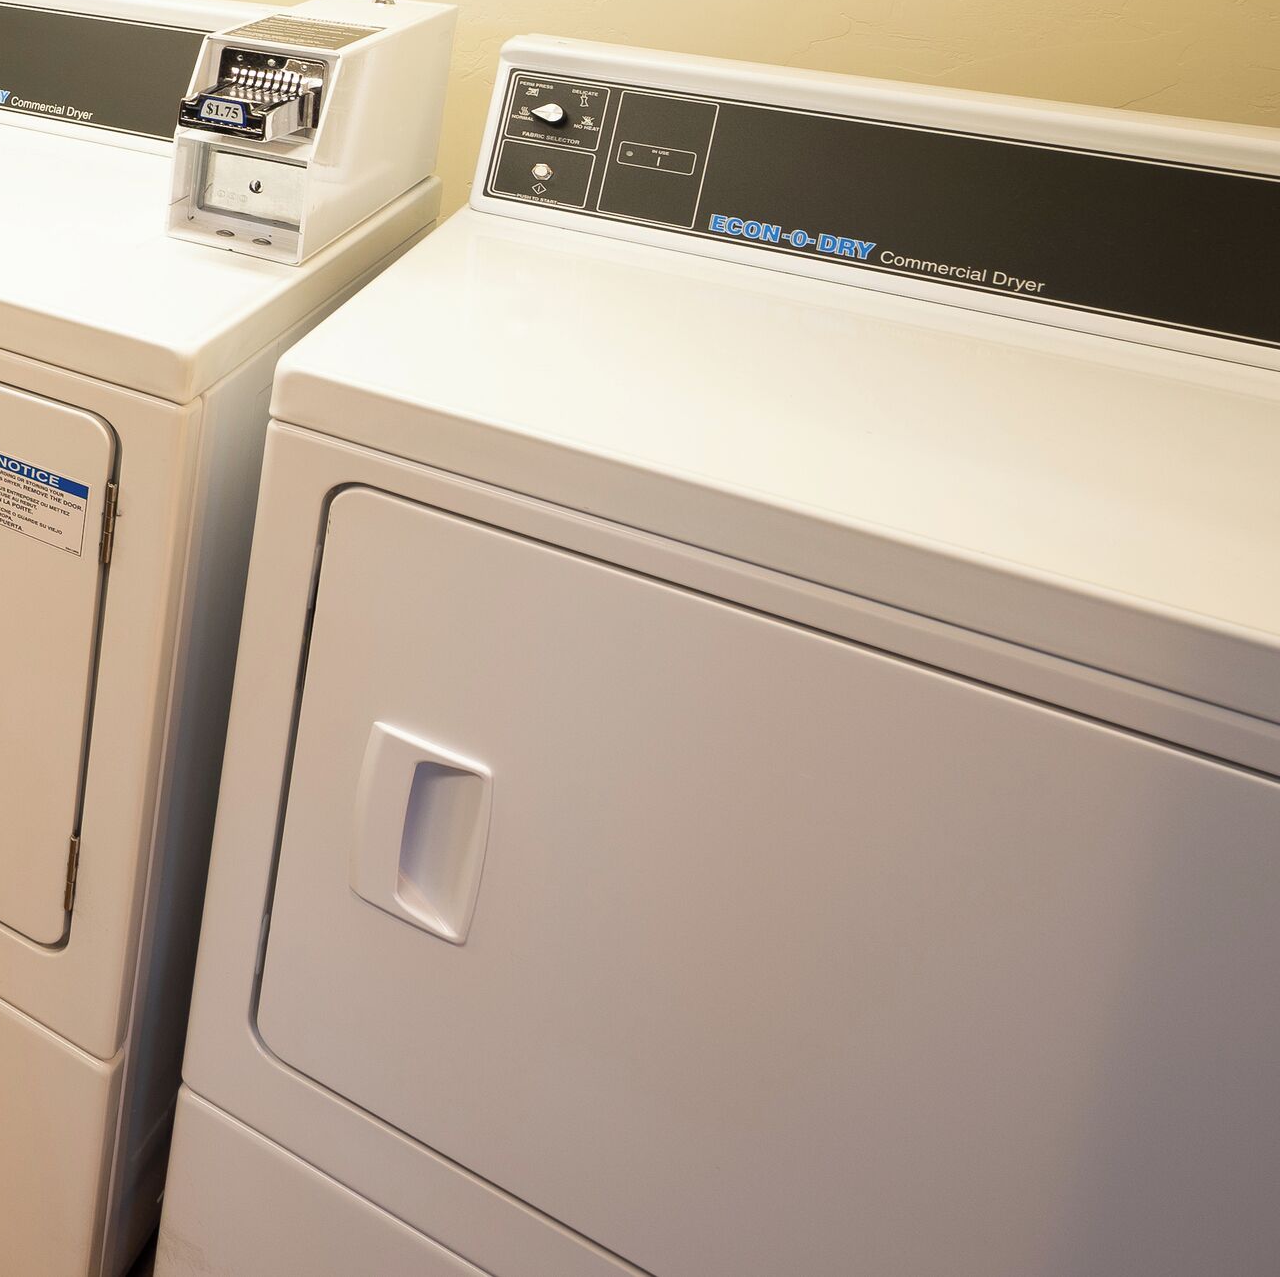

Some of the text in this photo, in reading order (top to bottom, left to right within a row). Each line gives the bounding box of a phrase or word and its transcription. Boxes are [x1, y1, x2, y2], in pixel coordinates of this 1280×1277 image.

[11, 96, 65, 115] Commercial
[66, 106, 93, 120] Dryer
[206, 103, 239, 119] $1.75
[522, 131, 580, 144] FABRIC SELECTOR
[540, 197, 557, 205] START
[708, 213, 1045, 293] ECON-O-DRY Commercial Dryer
[4, 478, 22, 489] DRYER,
[23, 485, 48, 499] REMOVE
[50, 495, 62, 504] THE
[63, 500, 83, 511] DOOR.
[26, 479, 49, 492] STORING
[50, 488, 64, 498] YOUR
[3, 498, 11, 506] LA
[12, 502, 34, 514] PORTE.
[7, 487, 39, 505] ENTREPOSEZ
[49, 505, 70, 516] METTEZ
[0, 512, 13, 521] ROPA,
[0, 518, 24, 531] PUERTA.
[18, 513, 39, 525] GUARDE
[47, 526, 63, 535] VIEJO
